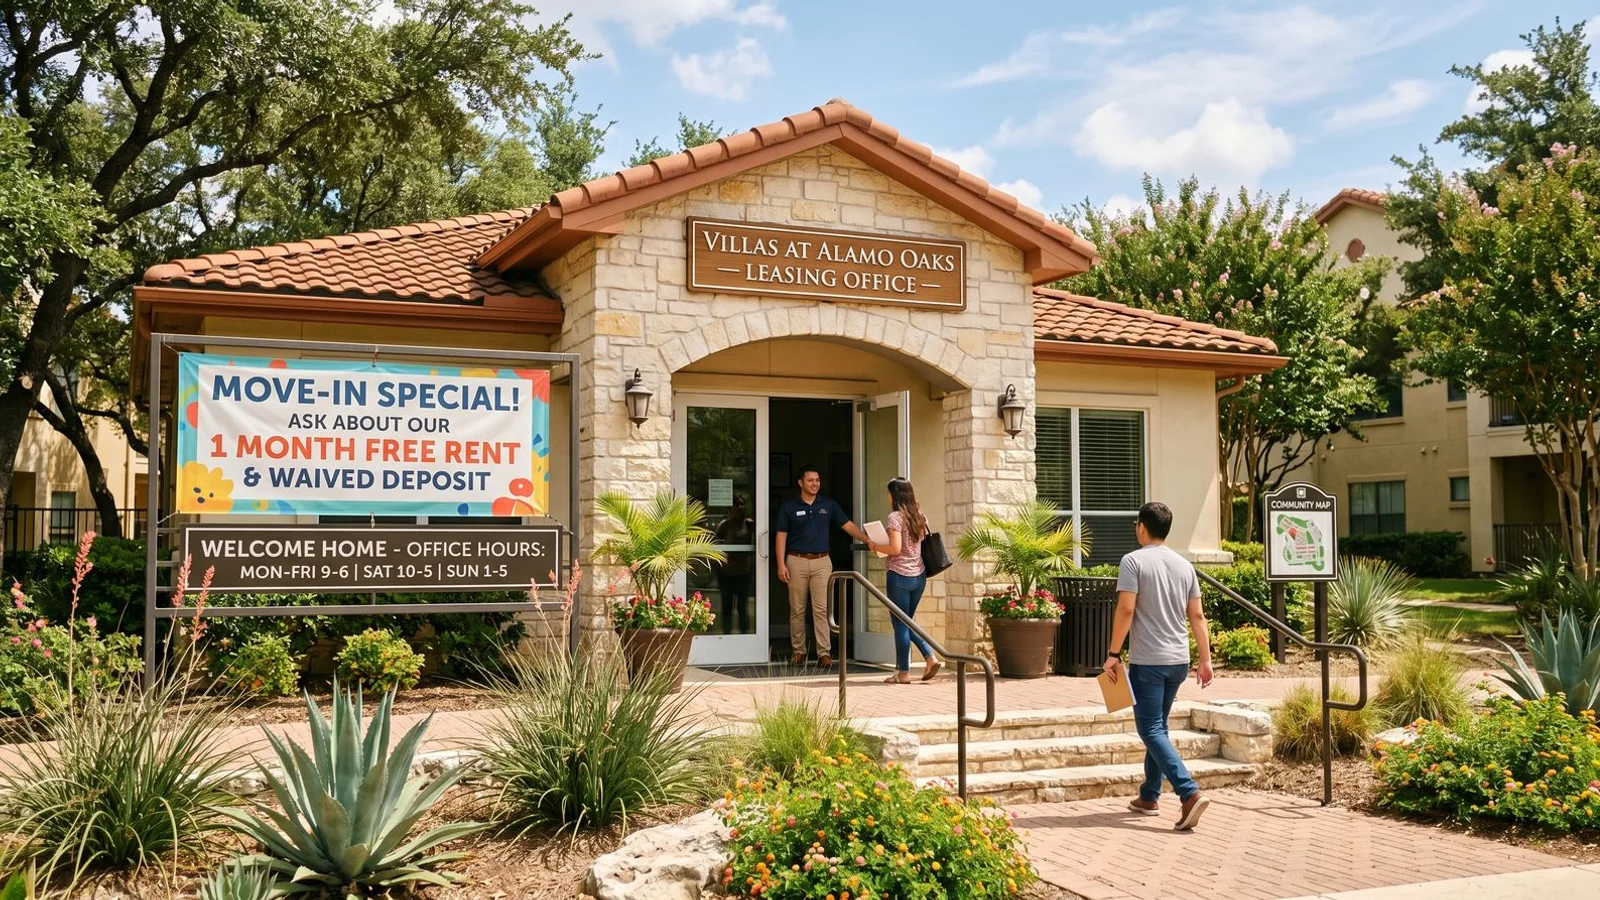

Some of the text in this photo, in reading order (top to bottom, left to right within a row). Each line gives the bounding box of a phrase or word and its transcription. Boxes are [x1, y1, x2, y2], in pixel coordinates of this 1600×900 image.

[785, 241, 811, 259] AT
[746, 263, 917, 293] LEASING OFFICE
[212, 375, 520, 411] MOVE-IN SPECIAL!
[288, 413, 450, 433] ASK ABOUT OUR
[210, 434, 521, 464] 1 MONTH FREE RENT
[242, 466, 491, 491] & WAIVED DEPOSIT
[1271, 501, 1331, 509] COMMUNITY MAP
[201, 540, 316, 558] WELCOME
[321, 541, 387, 558] HOME
[407, 541, 473, 557] OFFICE
[477, 541, 545, 557] HOURS:
[240, 564, 315, 579] MON-FRI
[320, 564, 348, 579] 9-6
[363, 564, 393, 579] SAT
[396, 564, 433, 579] 10-5
[446, 563, 480, 578] SUN
[483, 563, 508, 578] 1-5
